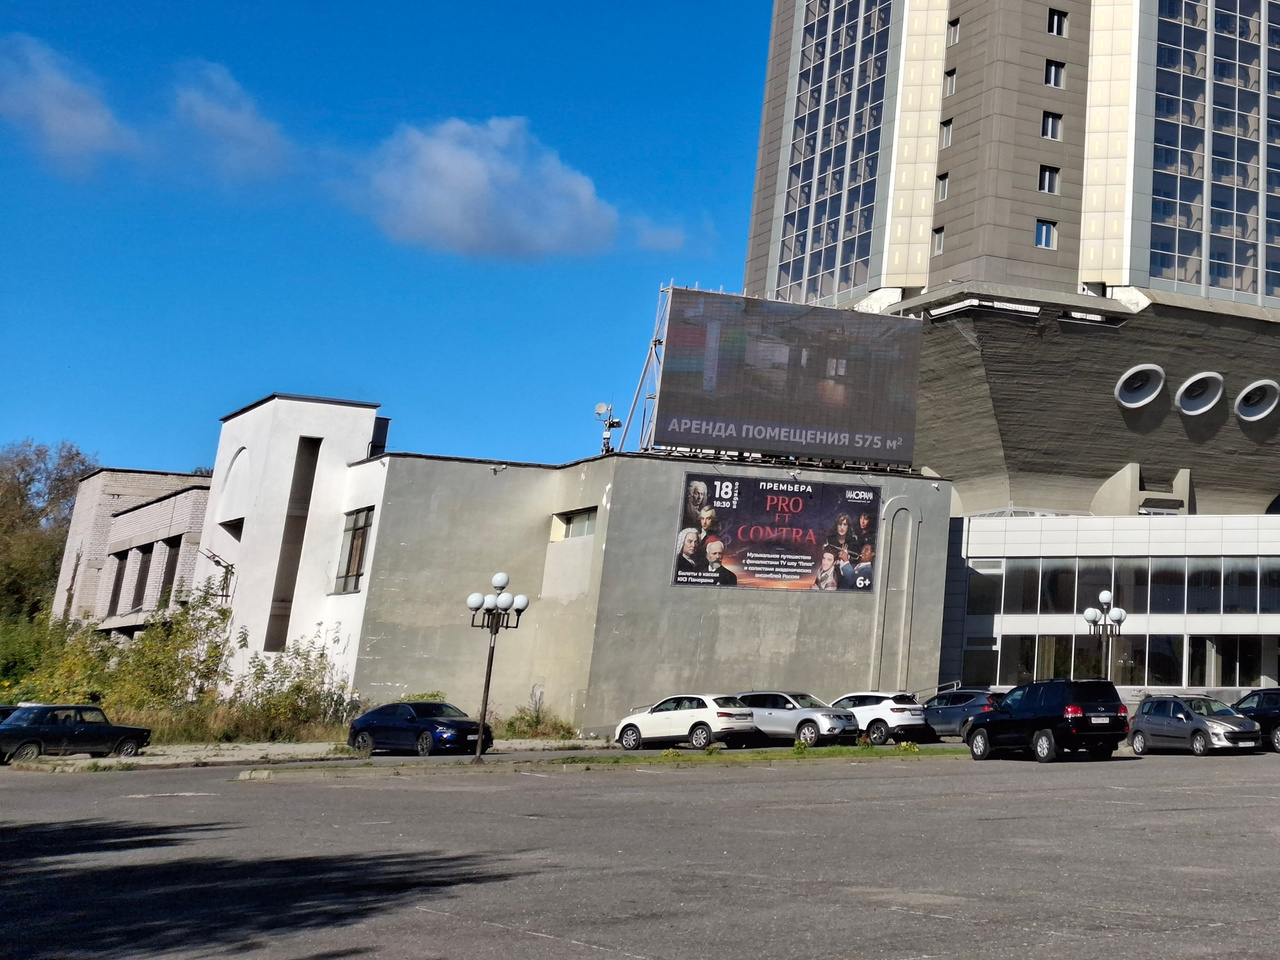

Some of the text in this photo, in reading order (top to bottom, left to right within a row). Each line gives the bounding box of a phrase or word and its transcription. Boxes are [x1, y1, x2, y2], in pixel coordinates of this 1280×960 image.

[667, 418, 737, 438] АРЕНДА
[741, 424, 850, 446] ПОМЕЩЕНИЯ
[853, 434, 882, 449] 575
[714, 481, 733, 499] 18
[759, 481, 813, 493] ПРЕМЬЕРА
[713, 500, 731, 508] 18:30
[766, 494, 804, 513] PRO
[737, 525, 817, 545] CONTRA
[856, 576, 871, 588] 6+
